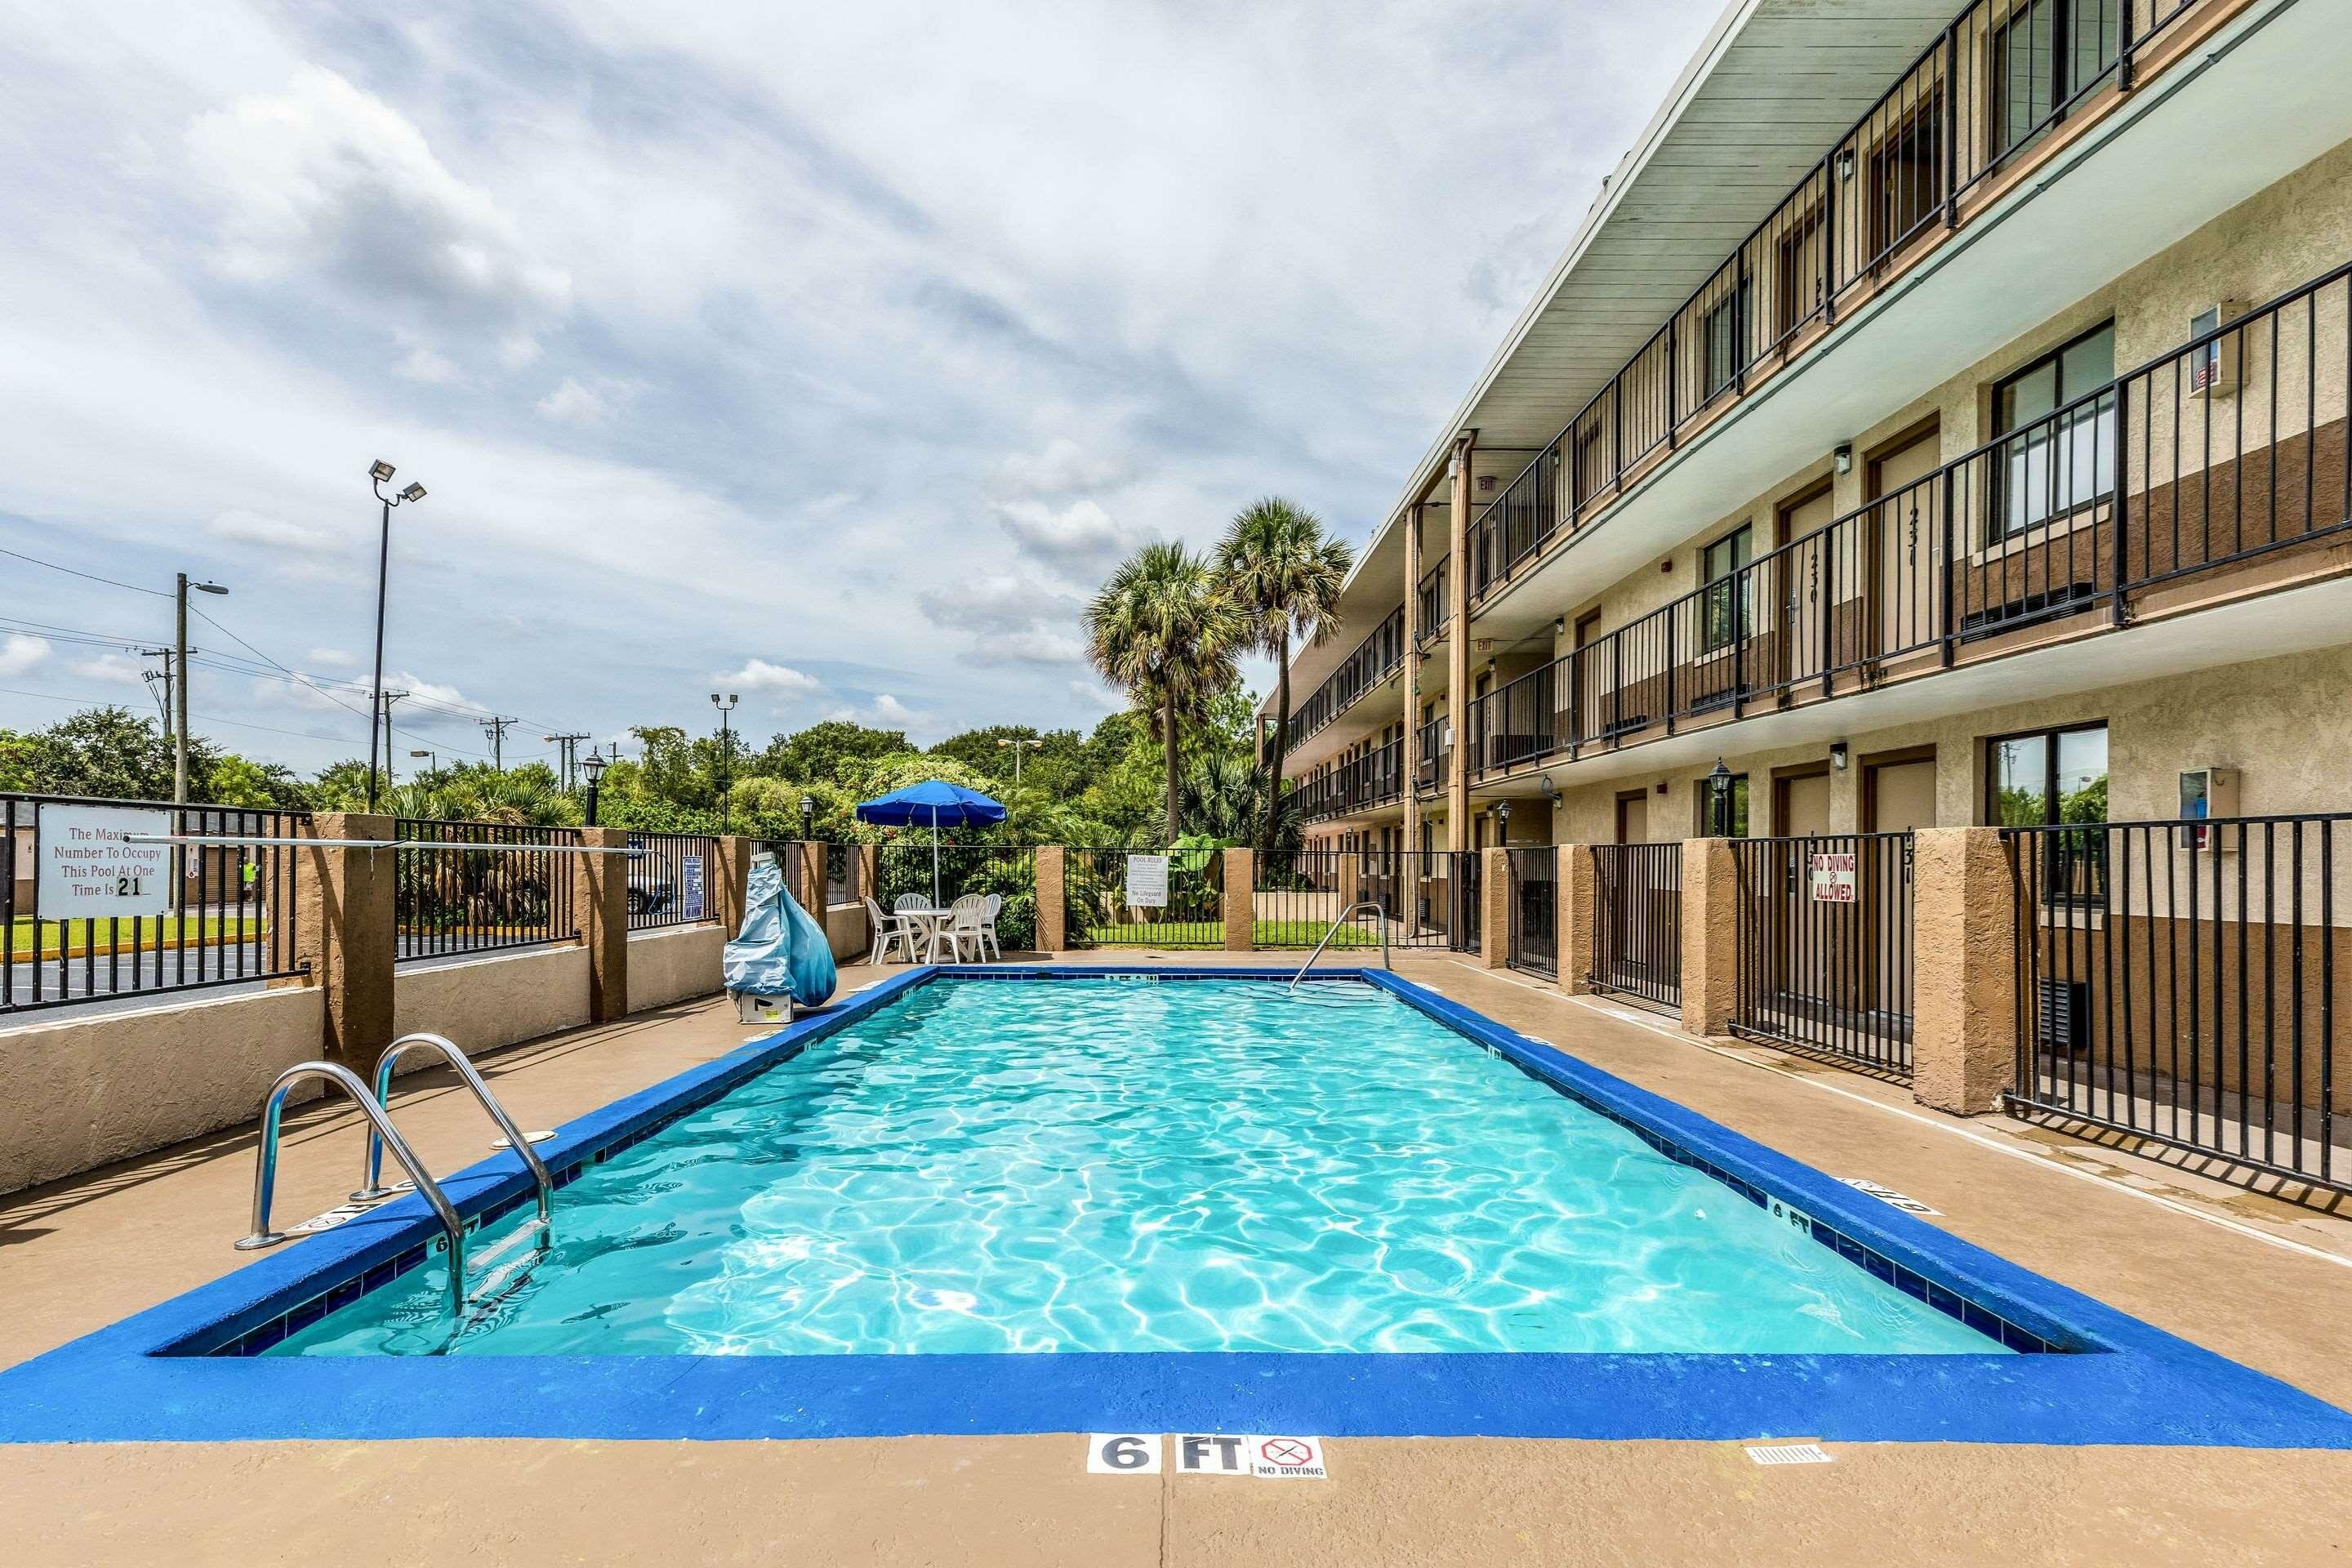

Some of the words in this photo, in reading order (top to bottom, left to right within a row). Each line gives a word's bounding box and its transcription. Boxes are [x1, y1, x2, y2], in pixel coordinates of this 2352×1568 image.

[69, 827, 91, 840] The
[54, 846, 103, 858] Number
[106, 847, 119, 858] To
[122, 847, 161, 861] Occupy
[61, 866, 87, 877] This
[91, 865, 115, 877] Pool
[118, 865, 131, 876] At
[133, 864, 154, 875] One
[1814, 855, 1823, 871] NO
[1828, 855, 1854, 871] DIVING
[72, 884, 101, 896] Time
[105, 884, 114, 895] Is
[118, 877, 140, 896] 21
[1774, 1204, 1782, 1218] 6
[436, 1236, 448, 1253] 6
[1102, 1437, 1150, 1469] 6
[1183, 1436, 1242, 1470] FT
[1258, 1466, 1275, 1475] NO
[1281, 1467, 1325, 1476] DIVING
